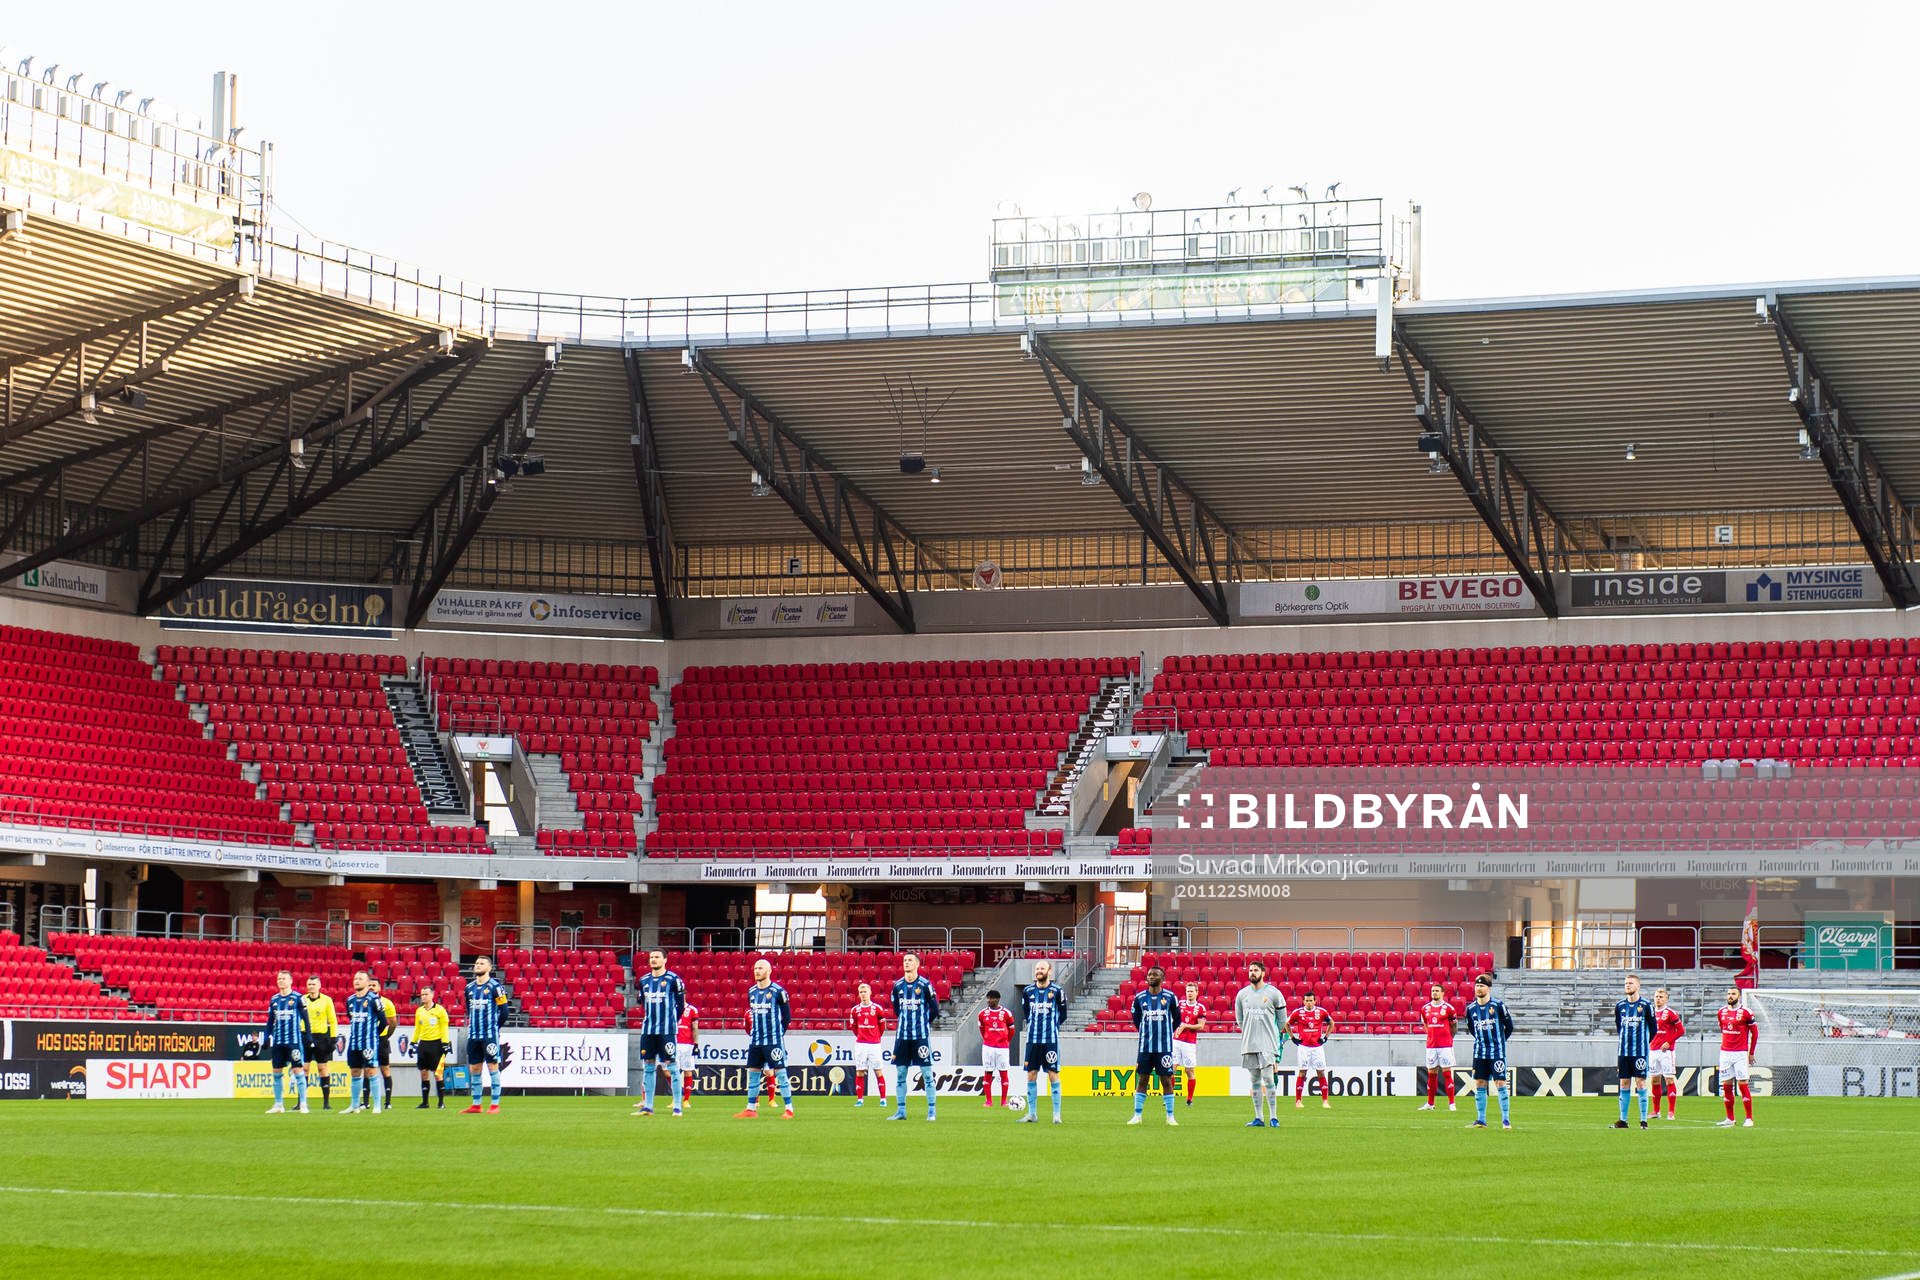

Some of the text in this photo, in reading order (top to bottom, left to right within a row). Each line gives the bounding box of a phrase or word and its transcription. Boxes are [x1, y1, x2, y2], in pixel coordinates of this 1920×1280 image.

[1718, 527, 1729, 543] E
[790, 559, 799, 574] F
[41, 570, 99, 595] Kalmarhem
[1787, 569, 1862, 585] MYSINGE
[1398, 578, 1523, 600] BEVEGO
[1787, 588, 1863, 601] STENHUGGERI
[166, 588, 361, 629] GuldFågeln
[450, 596, 487, 609] HÅLLER
[505, 600, 523, 610] KFF
[1275, 601, 1349, 614] Björkegrens Optik
[1438, 603, 1482, 611] VENTILATION
[1484, 602, 1520, 610] ISOLERING
[553, 604, 642, 621] infoservice
[1700, 878, 1741, 890] KIOSK
[890, 889, 927, 900] KIOSK
[37, 1030, 215, 1052] HOS OSS ÄR DET LÅGA TRÖSKLAR!
[521, 1045, 611, 1062] EKERUM
[106, 1062, 211, 1089] SHARP
[520, 1066, 567, 1075] RESORT
[4, 1073, 30, 1090] OSS!
[236, 1073, 272, 1088] RAMIRE
